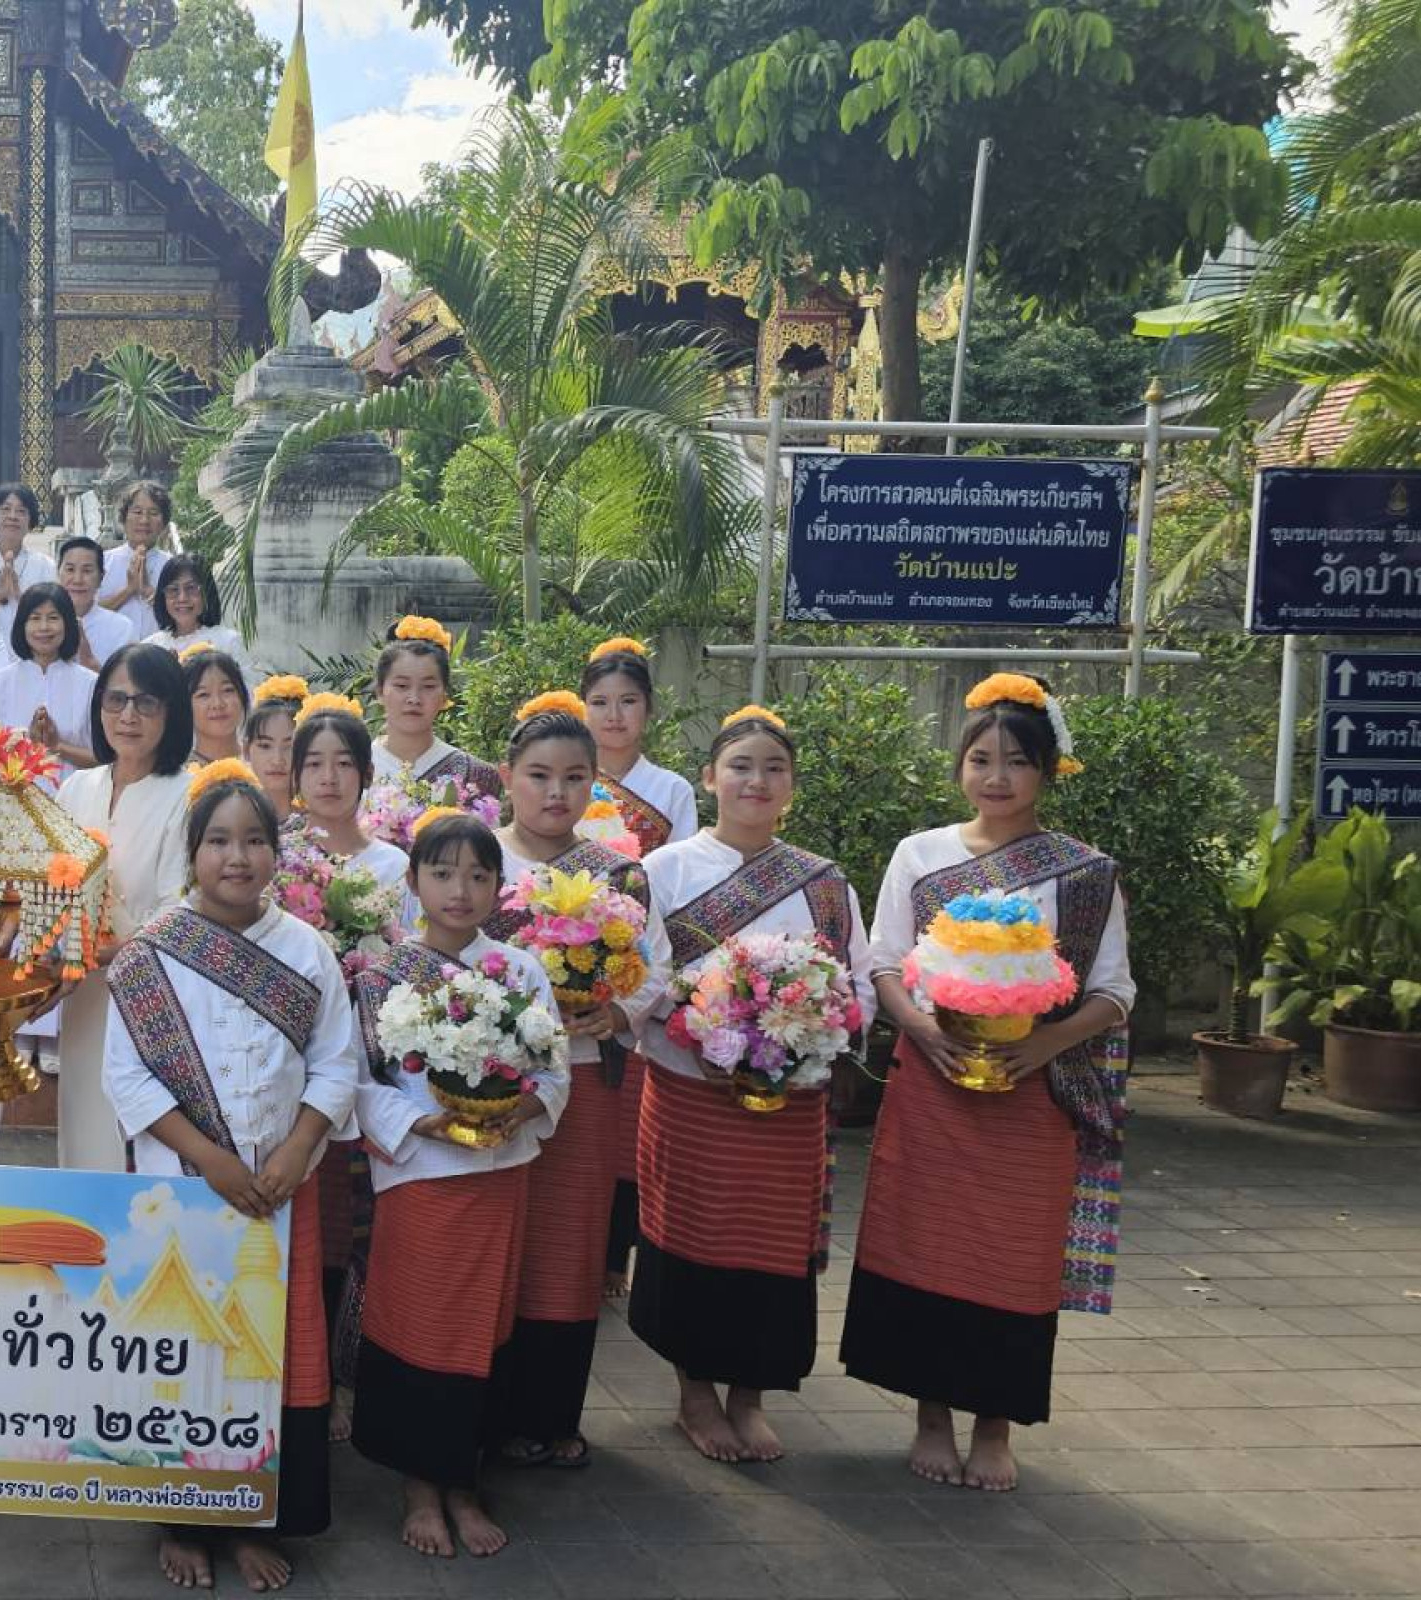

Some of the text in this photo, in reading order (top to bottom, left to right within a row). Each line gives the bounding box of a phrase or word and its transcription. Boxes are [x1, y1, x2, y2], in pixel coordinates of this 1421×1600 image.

[818, 473, 1104, 510] โครงการสวดมนต์เฉลิมพระเกียรติฯ
[807, 510, 1111, 548] เพื่อความสถิตสถาพรของแผ่นดินไทย
[893, 552, 1019, 581] วัดบ้านแปะ
[93, 1404, 260, 1449] ๒๕๖๘
[49, 1485, 78, 1501] ๘๑
[85, 1480, 99, 1501] ปี
[105, 1484, 261, 1510] หลวงพ่อธัมมชโย
